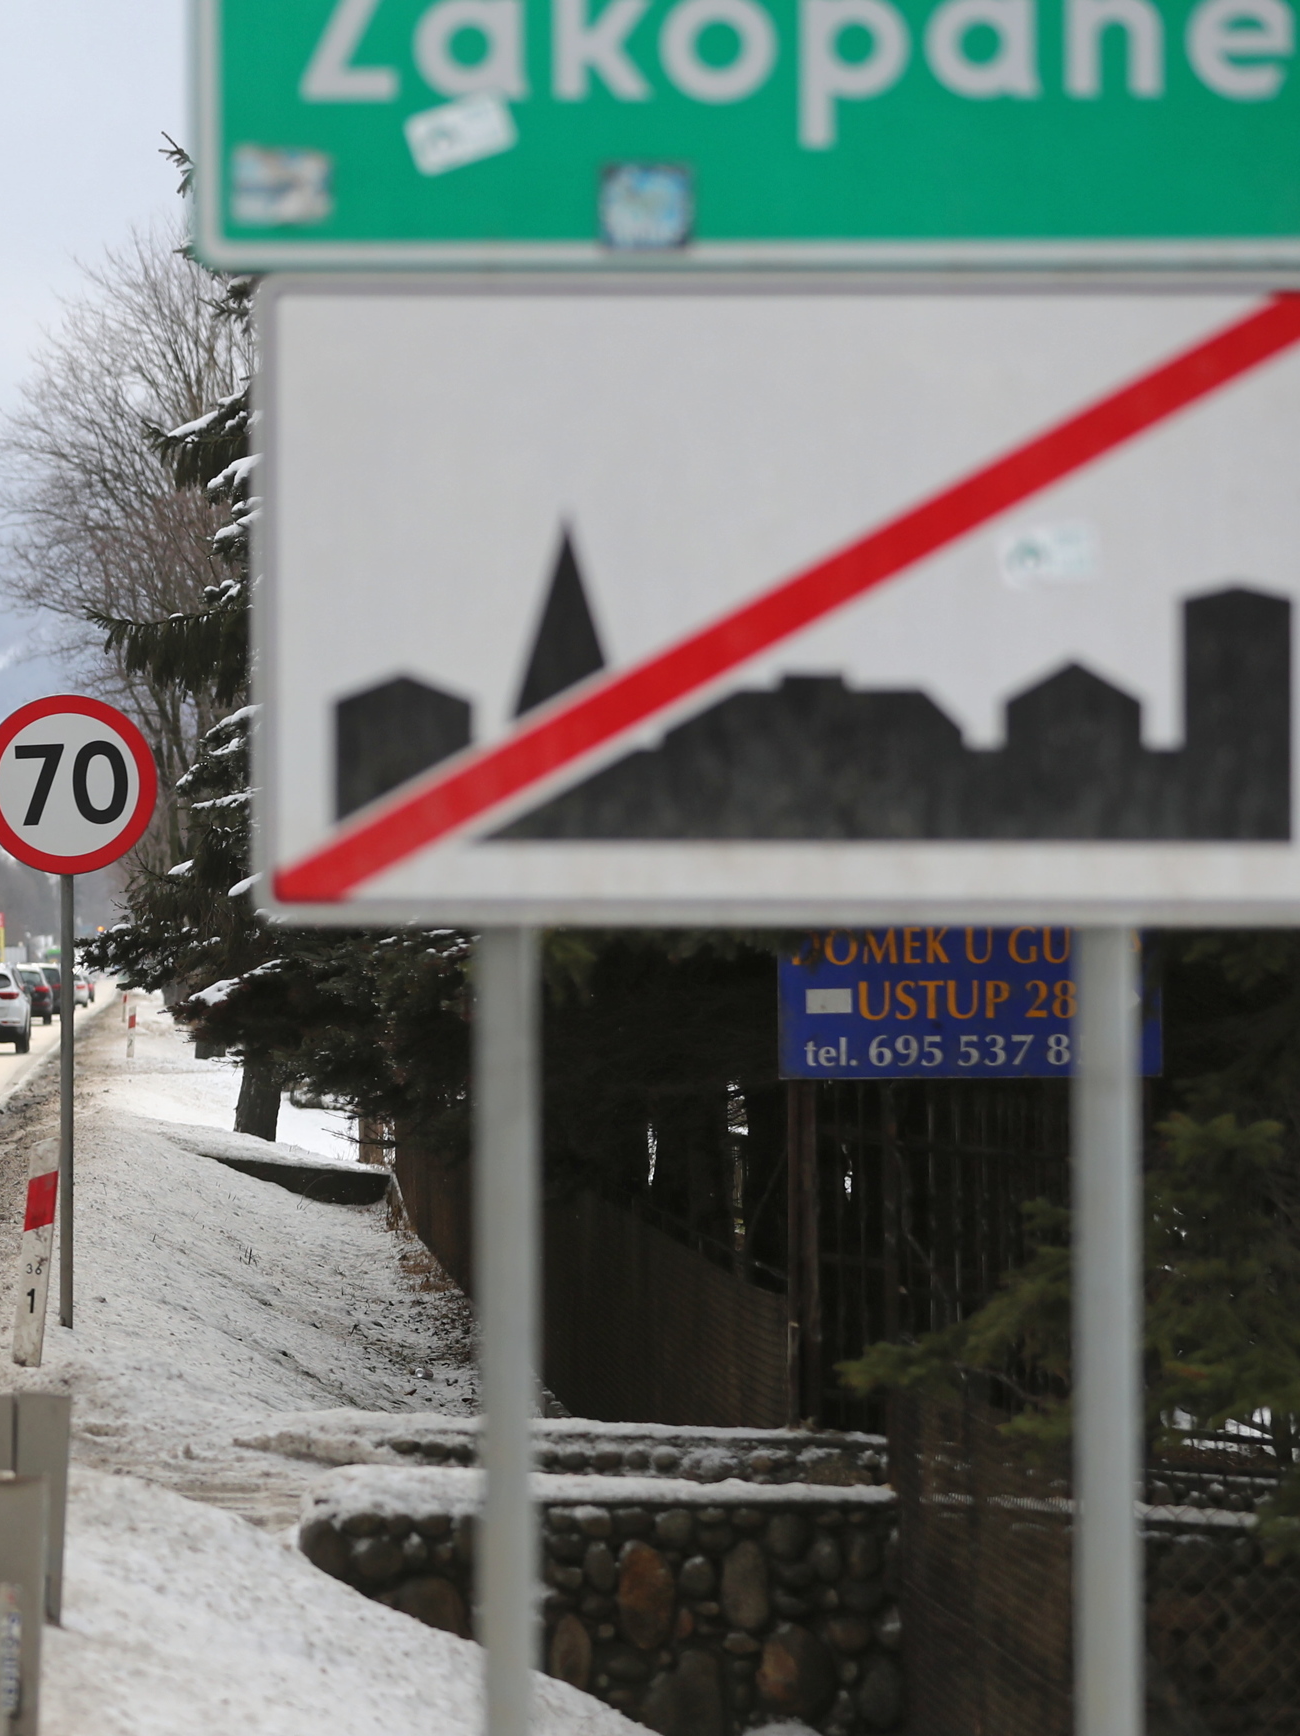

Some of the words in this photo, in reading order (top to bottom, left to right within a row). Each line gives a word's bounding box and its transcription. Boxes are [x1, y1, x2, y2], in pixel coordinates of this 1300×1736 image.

[301, 0, 1296, 150] Zakopane
[14, 740, 129, 826] 70
[965, 926, 992, 964] U
[857, 980, 1010, 1020] USTUP
[1025, 980, 1078, 1019] 28
[804, 1036, 858, 1067] tel.
[868, 1034, 943, 1067] 695
[957, 1034, 1034, 1066] 537
[25, 1263, 43, 1275] 36
[26, 1288, 36, 1314] 1
